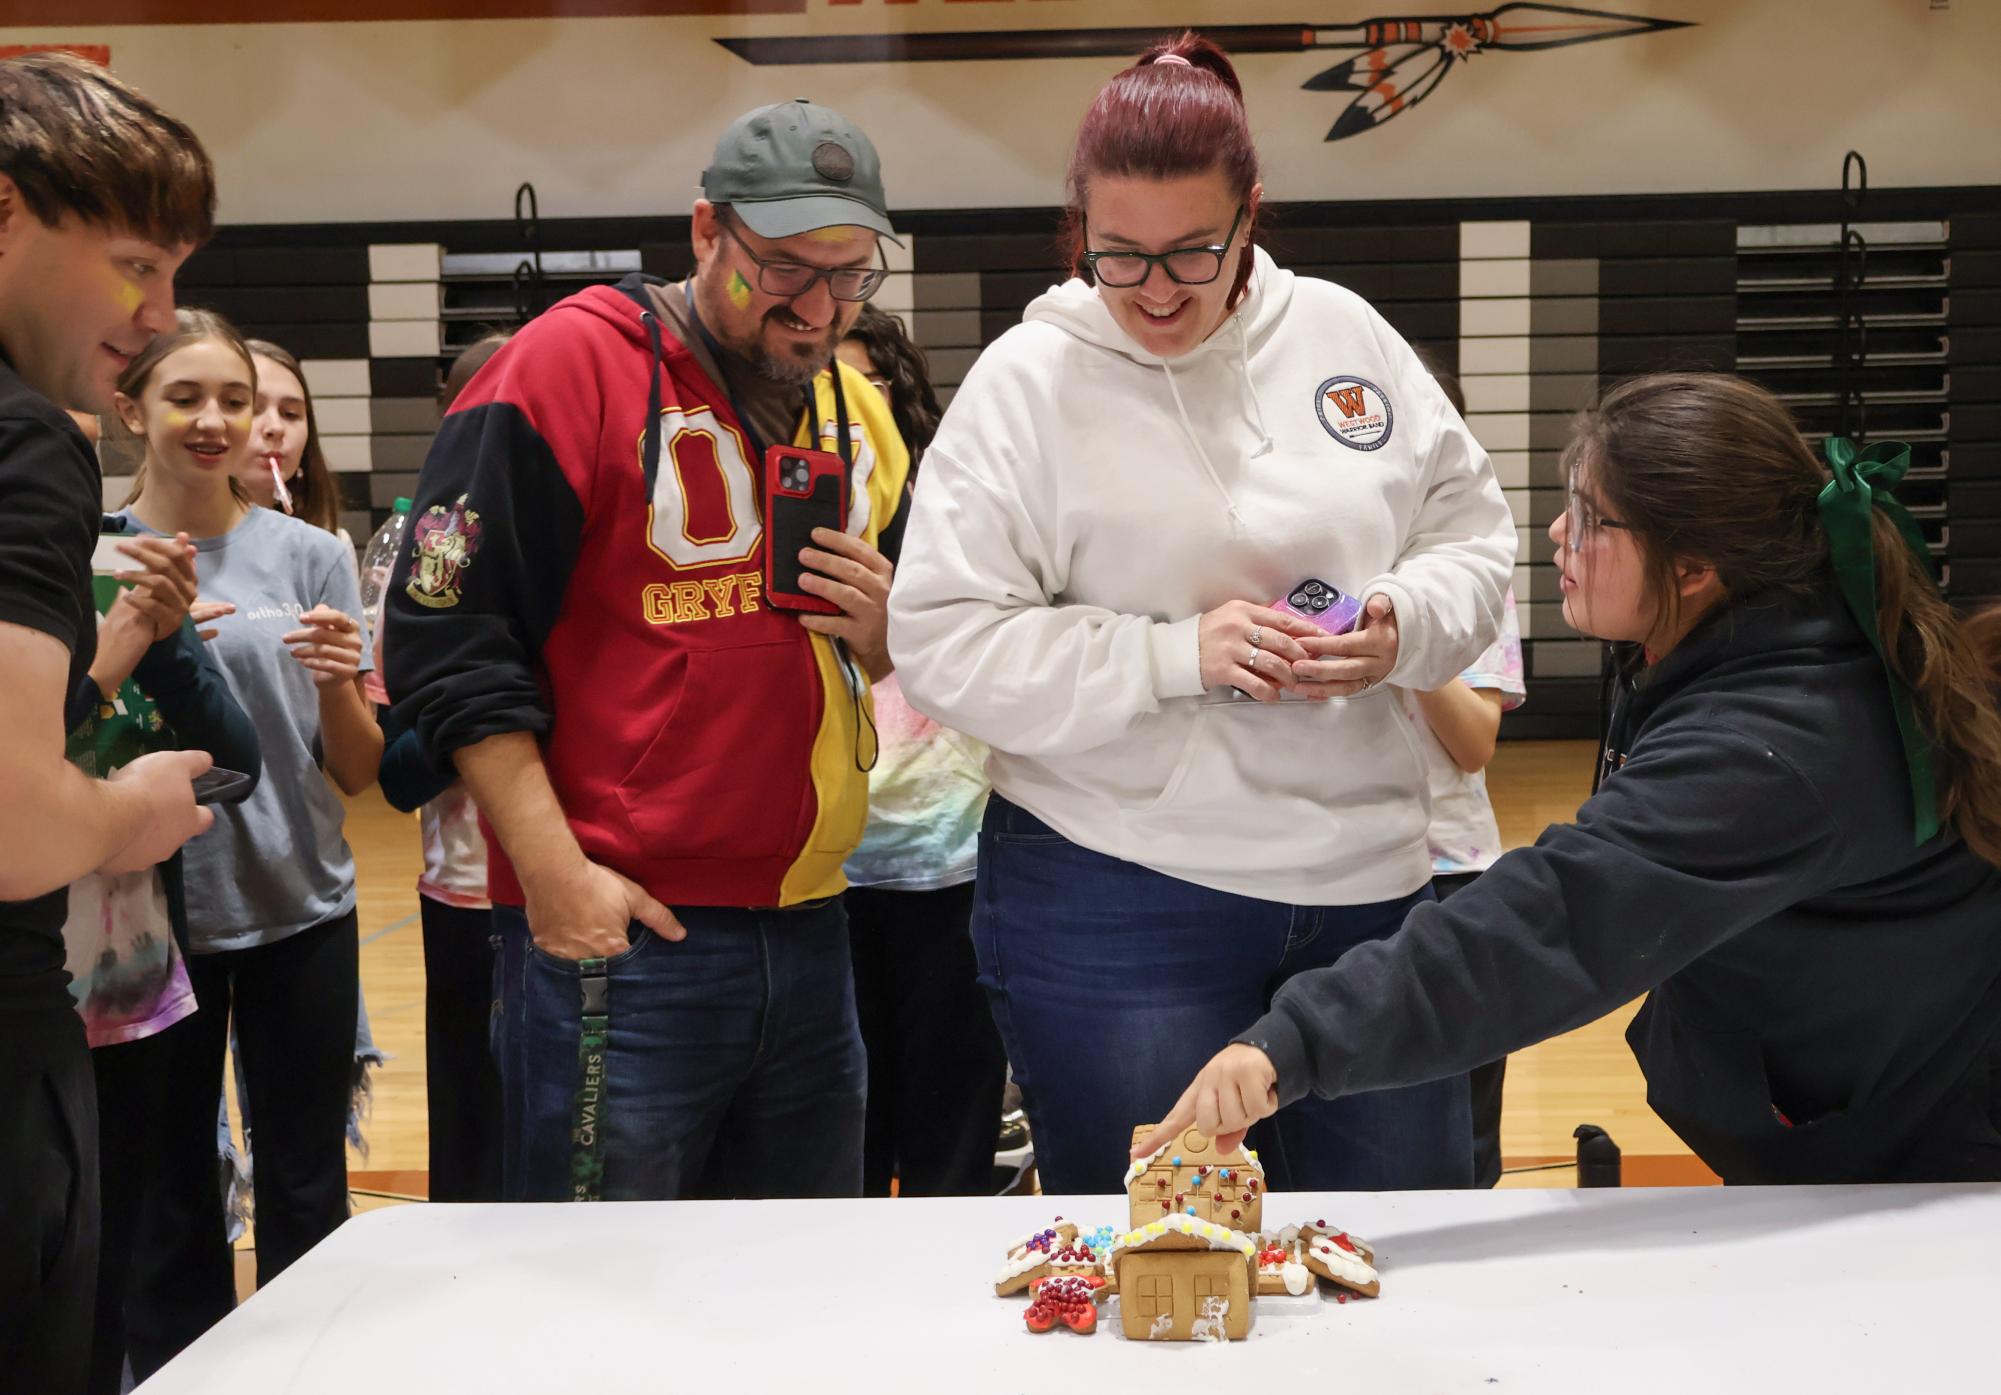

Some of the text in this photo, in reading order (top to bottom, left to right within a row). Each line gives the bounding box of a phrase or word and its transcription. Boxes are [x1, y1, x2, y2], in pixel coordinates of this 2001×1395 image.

[1326, 386, 1366, 418] W
[1338, 415, 1380, 428] WESTWOOD
[1341, 421, 1385, 434] WARRIOR BAND
[580, 1054, 601, 1146] CAVALIERS
